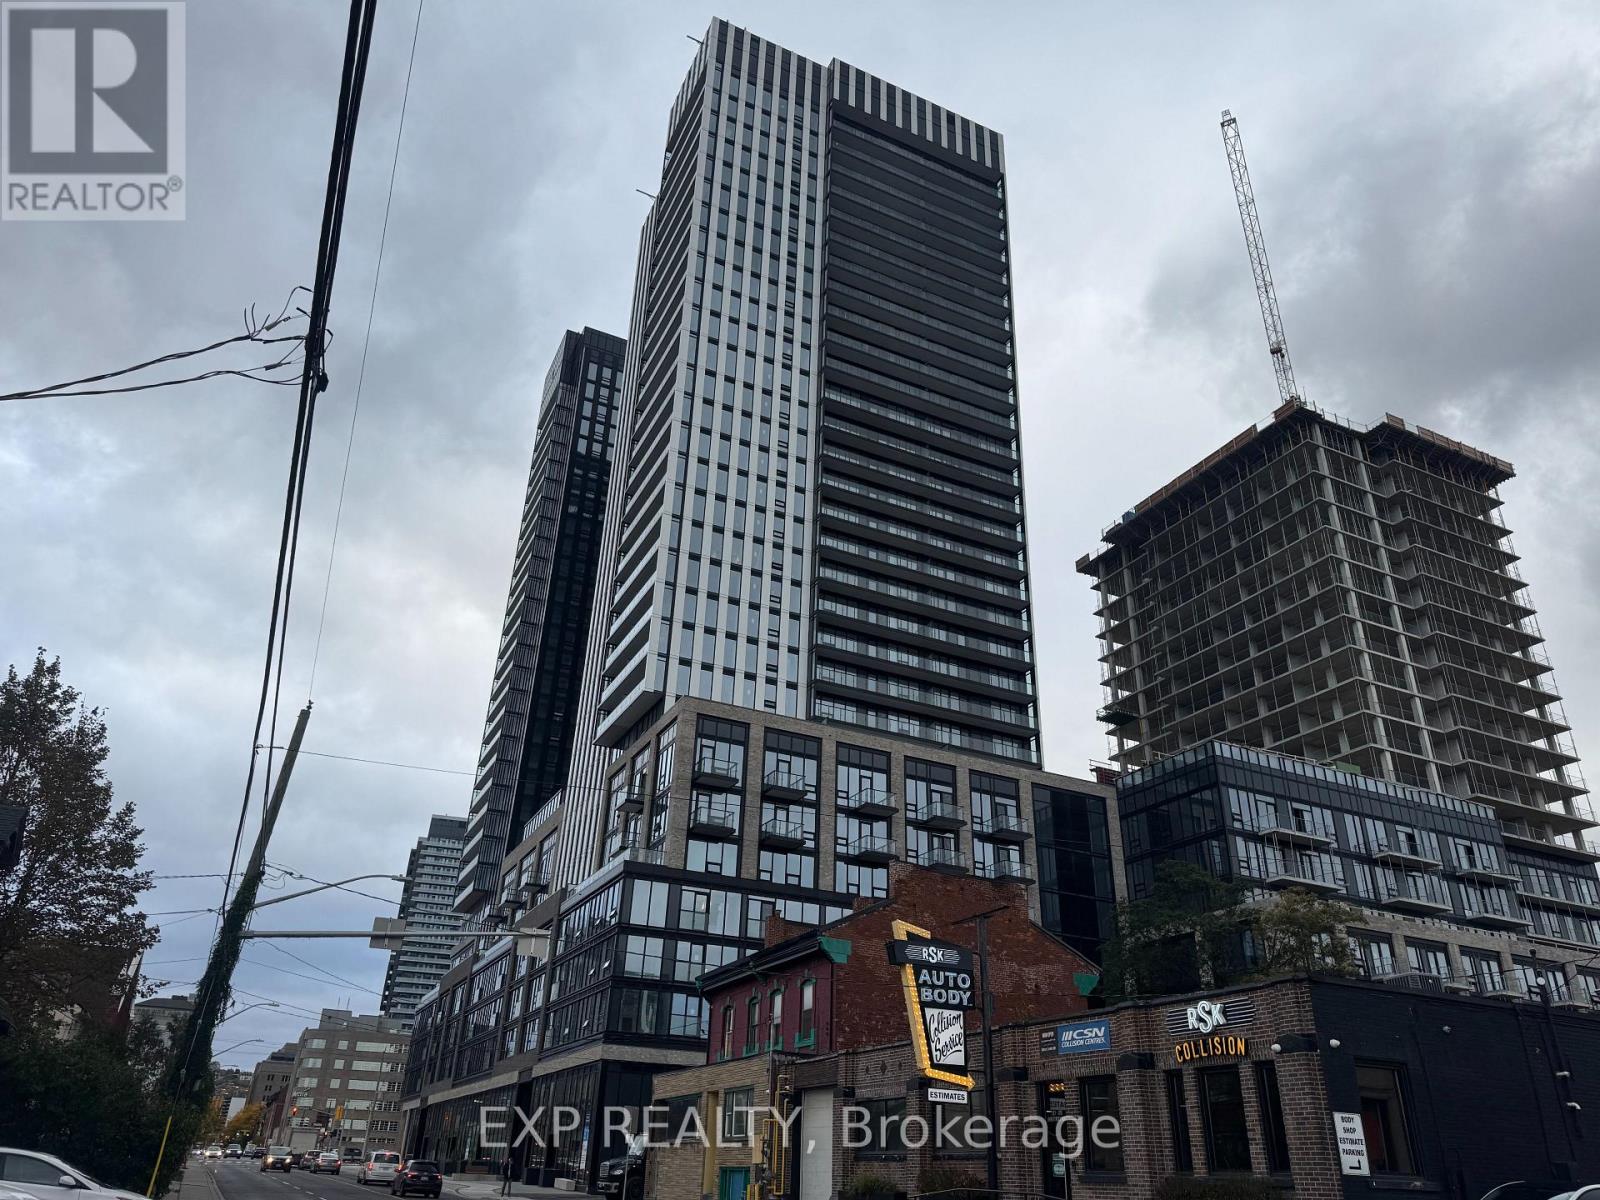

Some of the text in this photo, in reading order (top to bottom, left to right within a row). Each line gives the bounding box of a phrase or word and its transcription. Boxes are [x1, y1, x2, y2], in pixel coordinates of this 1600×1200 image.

[922, 946, 944, 964] RSK
[918, 969, 971, 989] AUTO
[920, 987, 971, 1006] BODY
[1187, 1001, 1226, 1033] RSK
[928, 1011, 963, 1043] Collision
[934, 1031, 963, 1062] Service
[1061, 1039, 1084, 1048] COLLISION
[1175, 1036, 1245, 1062] COLLISION
[929, 1091, 965, 1101] ESTIMATES
[1342, 1126, 1356, 1134] SHOP
[1339, 1137, 1364, 1145] ESTIMATE
[1342, 1148, 1364, 1156] PARKING
